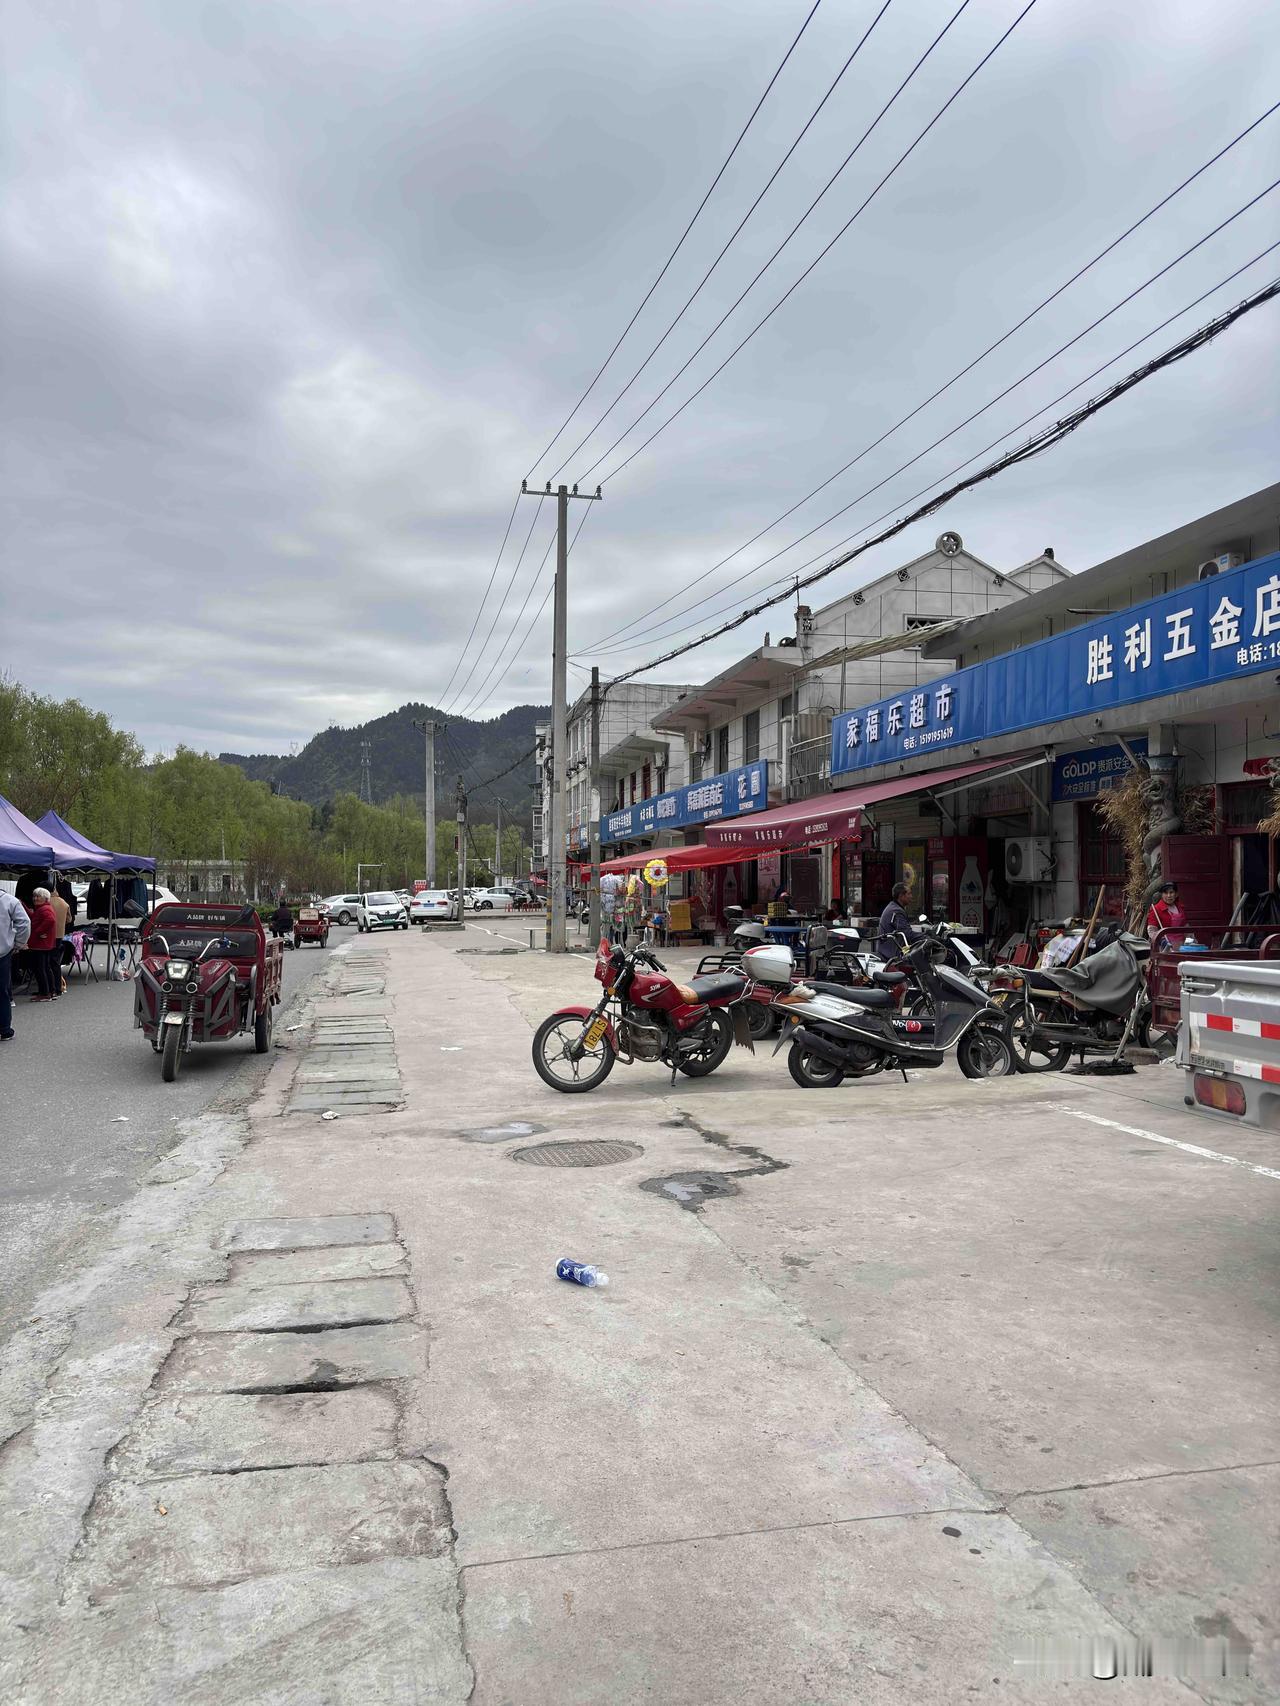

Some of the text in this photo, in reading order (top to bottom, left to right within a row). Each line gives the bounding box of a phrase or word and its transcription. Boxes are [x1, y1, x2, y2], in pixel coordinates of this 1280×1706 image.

[1086, 574, 1280, 686] 胜利五金店
[846, 683, 953, 749] 家福乐超市
[1062, 751, 1146, 778] GOLDP 贵派安全关
